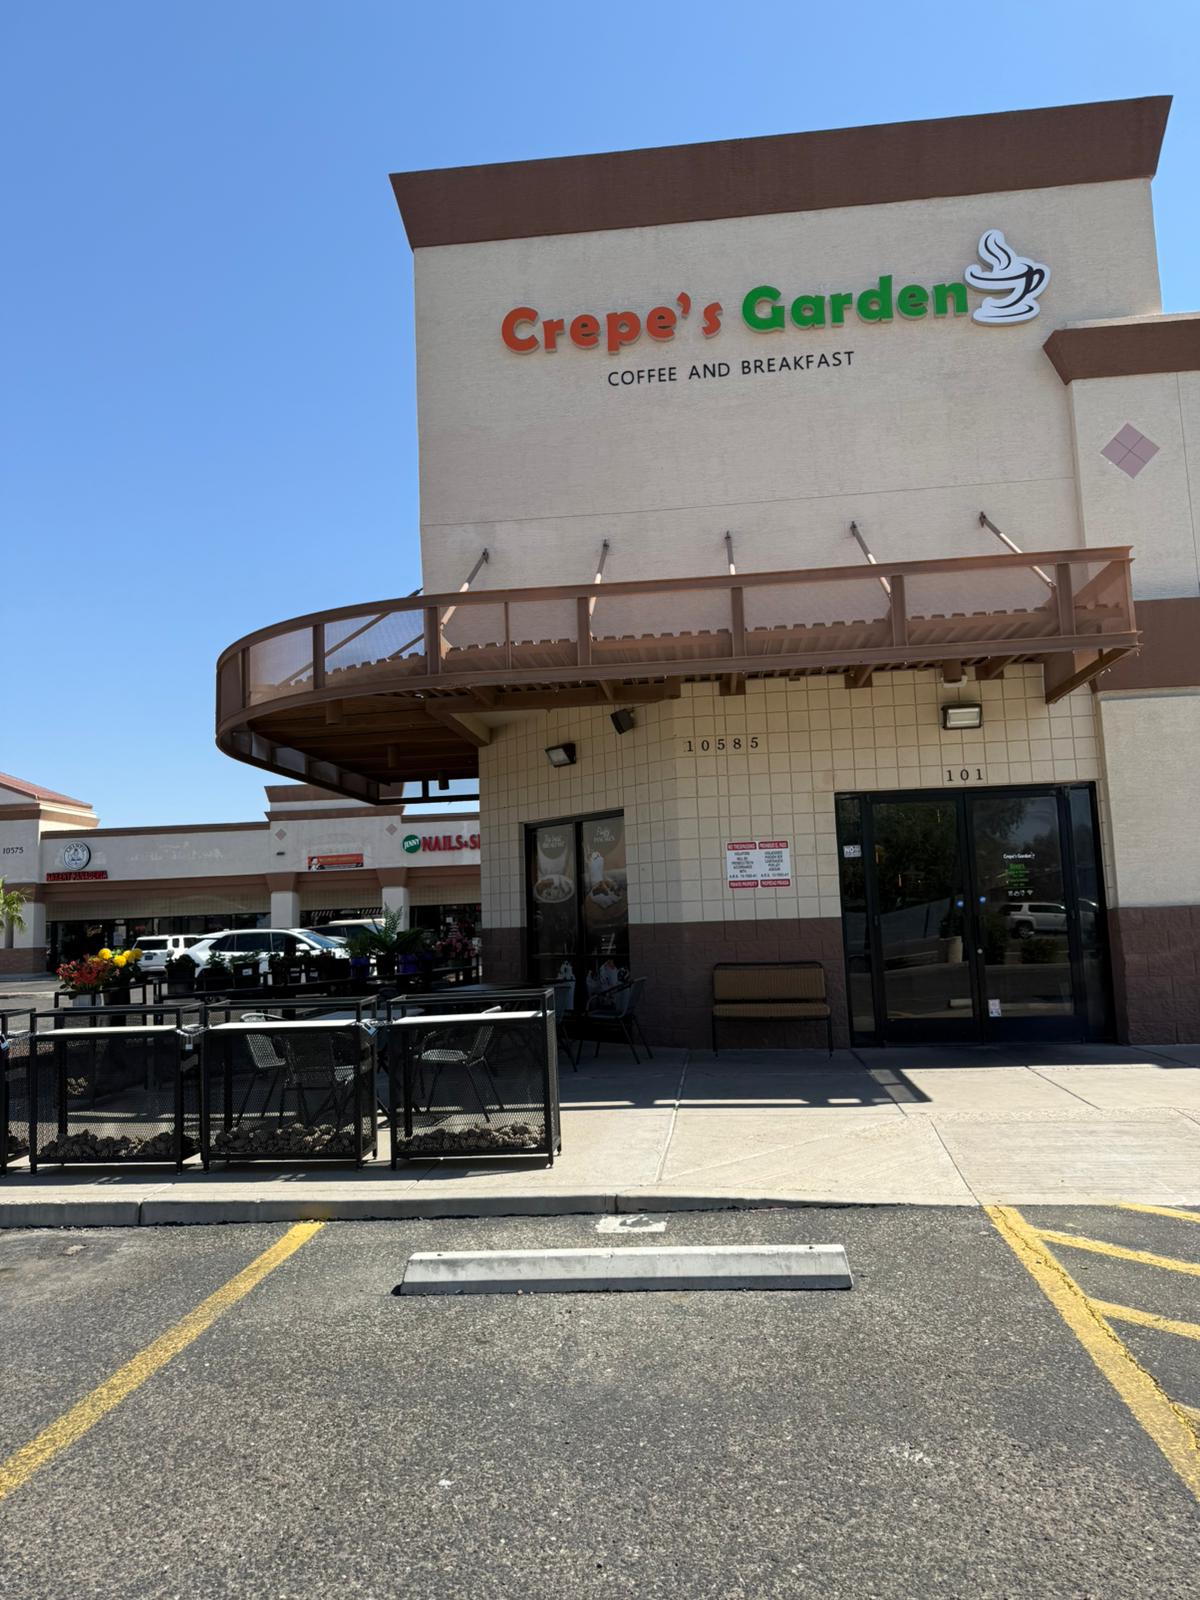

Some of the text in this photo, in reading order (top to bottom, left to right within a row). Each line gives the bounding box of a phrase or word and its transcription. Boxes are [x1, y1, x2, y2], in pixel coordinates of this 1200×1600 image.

[501, 274, 969, 356] Crepe's Garden
[607, 350, 855, 387] COFFEE AND BREAKFAST
[686, 737, 759, 752] 10585
[946, 768, 984, 782] 101
[3, 846, 24, 854] 10575
[403, 838, 419, 850] JENNY
[421, 834, 462, 852] NAILS
